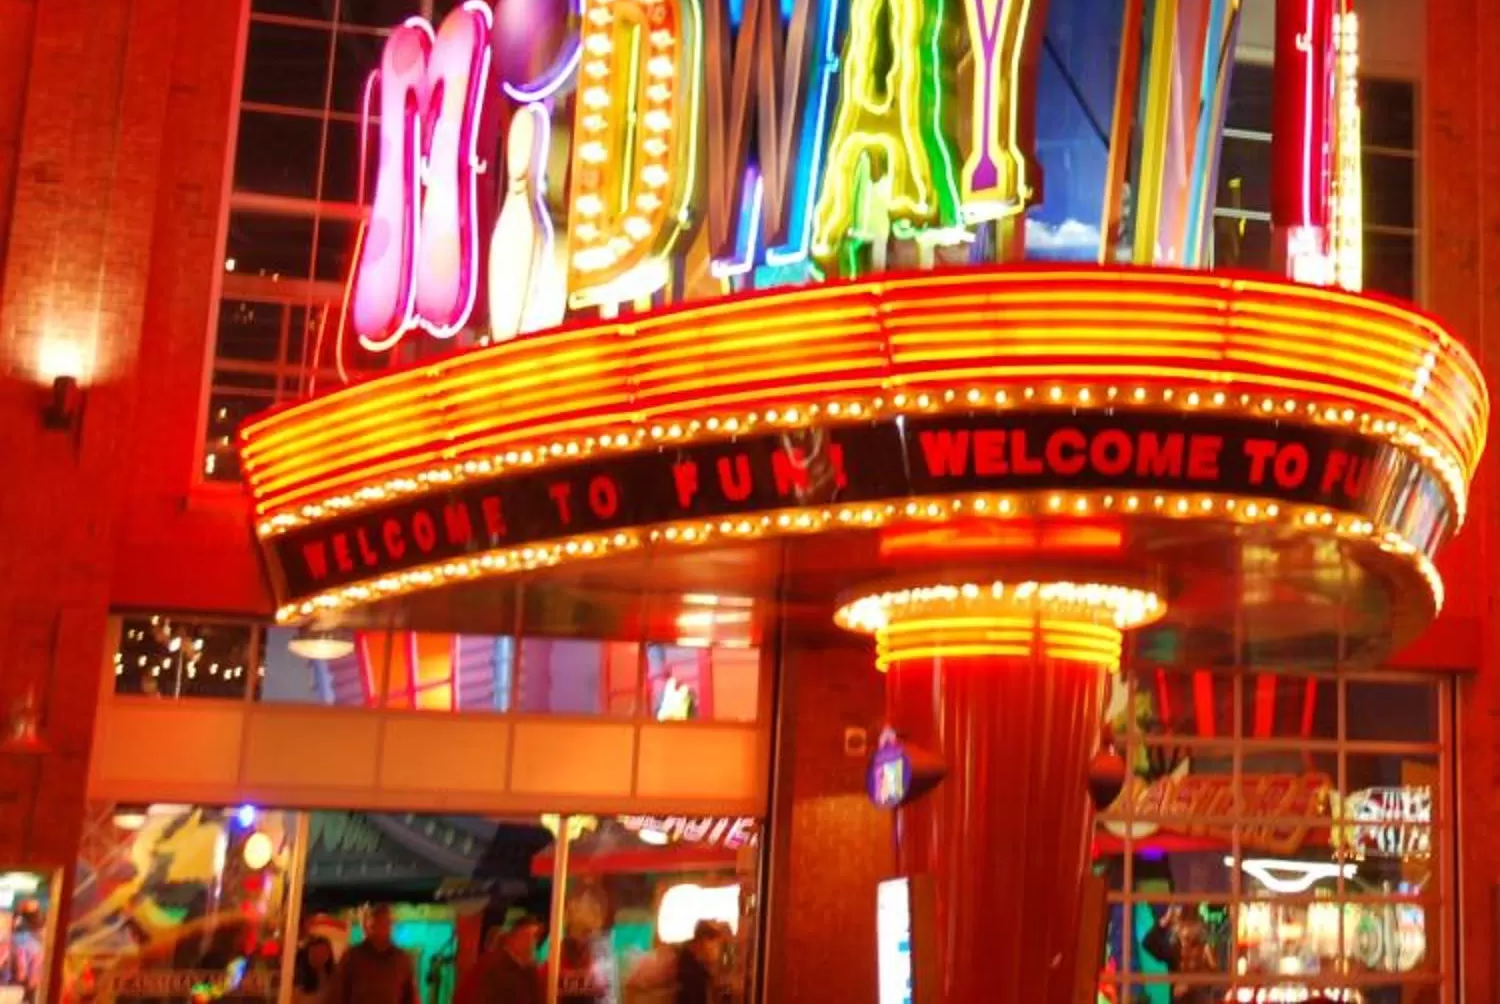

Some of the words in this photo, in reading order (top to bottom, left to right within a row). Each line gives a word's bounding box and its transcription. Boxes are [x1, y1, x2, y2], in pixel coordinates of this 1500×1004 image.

[919, 429, 1224, 479] WELCOME
[1244, 439, 1309, 489] TO
[303, 496, 508, 581] WELCOME
[549, 475, 619, 524] TO
